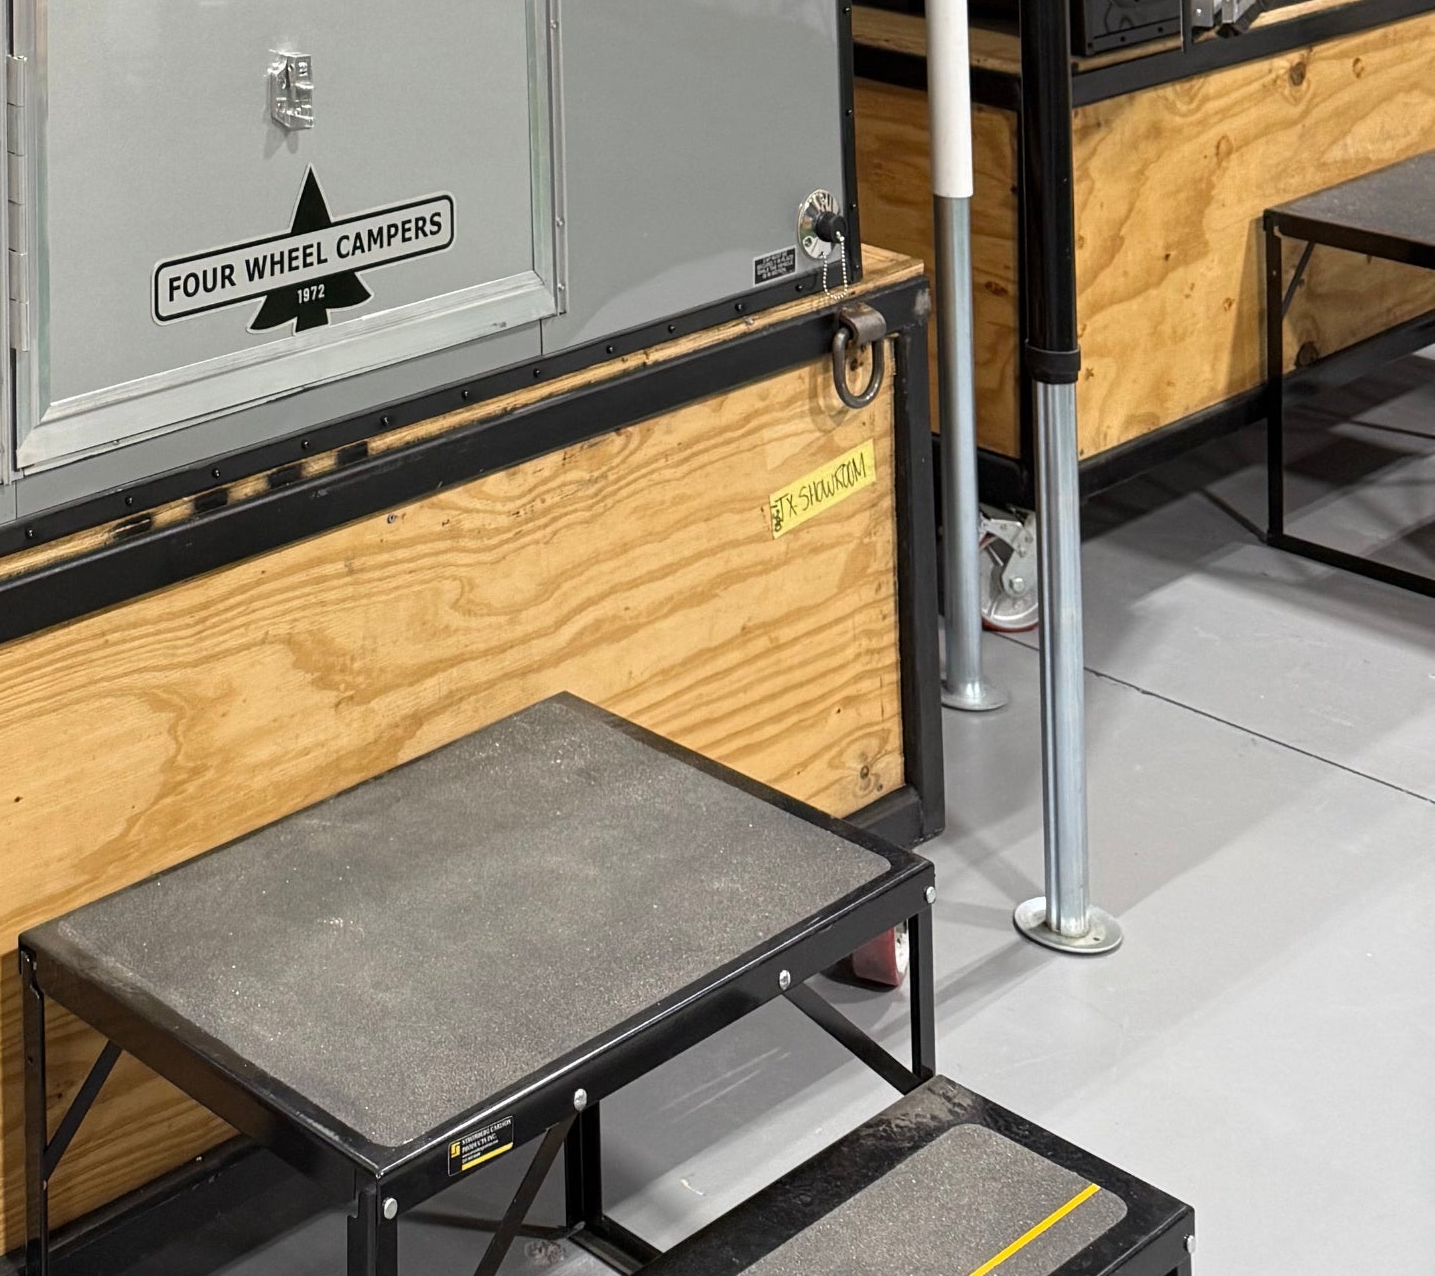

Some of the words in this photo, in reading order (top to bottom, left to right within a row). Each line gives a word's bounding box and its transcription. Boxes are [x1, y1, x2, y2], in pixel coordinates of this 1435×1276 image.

[168, 263, 237, 302] FOUR
[245, 241, 328, 282] WHEEL
[336, 212, 443, 259] CAMPERS
[297, 284, 325, 304] 1972
